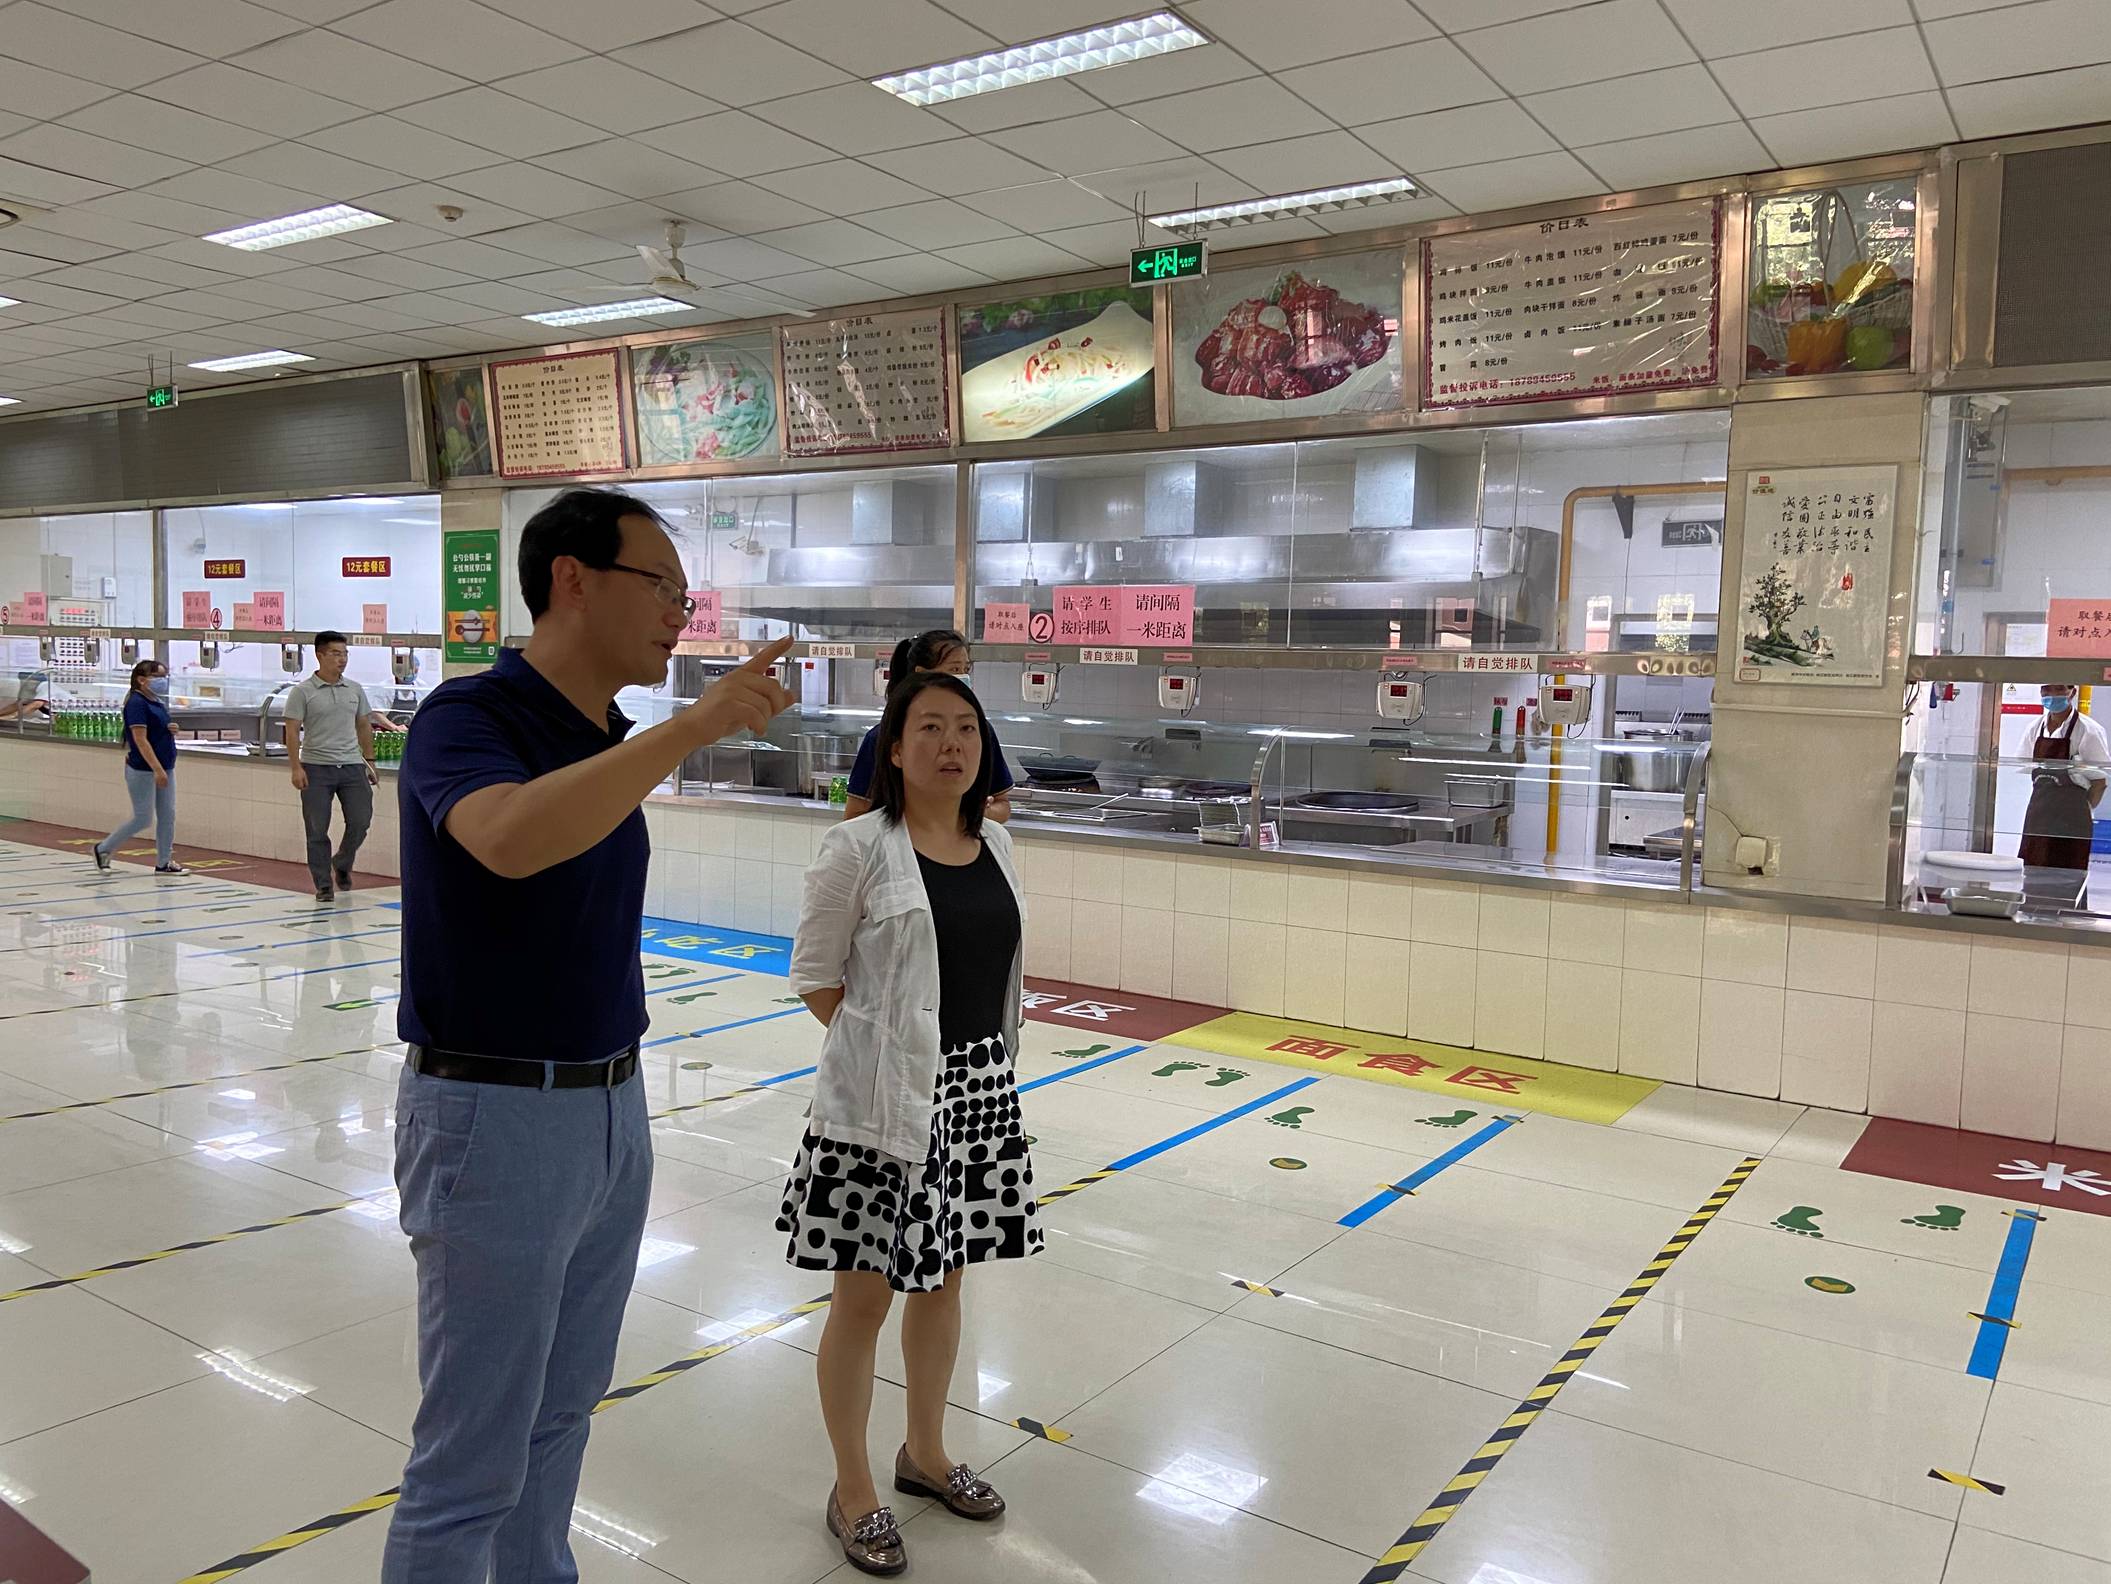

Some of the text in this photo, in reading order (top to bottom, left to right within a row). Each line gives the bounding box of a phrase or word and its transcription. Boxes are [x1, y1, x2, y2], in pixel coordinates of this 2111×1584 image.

[1539, 217, 1589, 234] 价目表
[1573, 244, 1603, 257] 11元/份
[1671, 231, 1699, 242] 7元/份
[1573, 271, 1603, 282] 11元/份
[1485, 307, 1513, 319] 11元/份
[1485, 331, 1513, 343] 11元/份
[1671, 309, 1697, 321] 7元/份
[346, 560, 386, 573] 12元套餐区
[1062, 595, 1112, 611] 请学生
[1135, 594, 1181, 611] 请间隔
[1061, 620, 1111, 635] 按序排队
[1126, 621, 1187, 639] 一米距离
[811, 645, 853, 657] 请自觉排队
[1083, 650, 1135, 663] 请自觉排队
[1462, 656, 1534, 671] 请自觉排队
[1264, 1033, 1540, 1095] 面食区
[1990, 1159, 2111, 1196] 米
